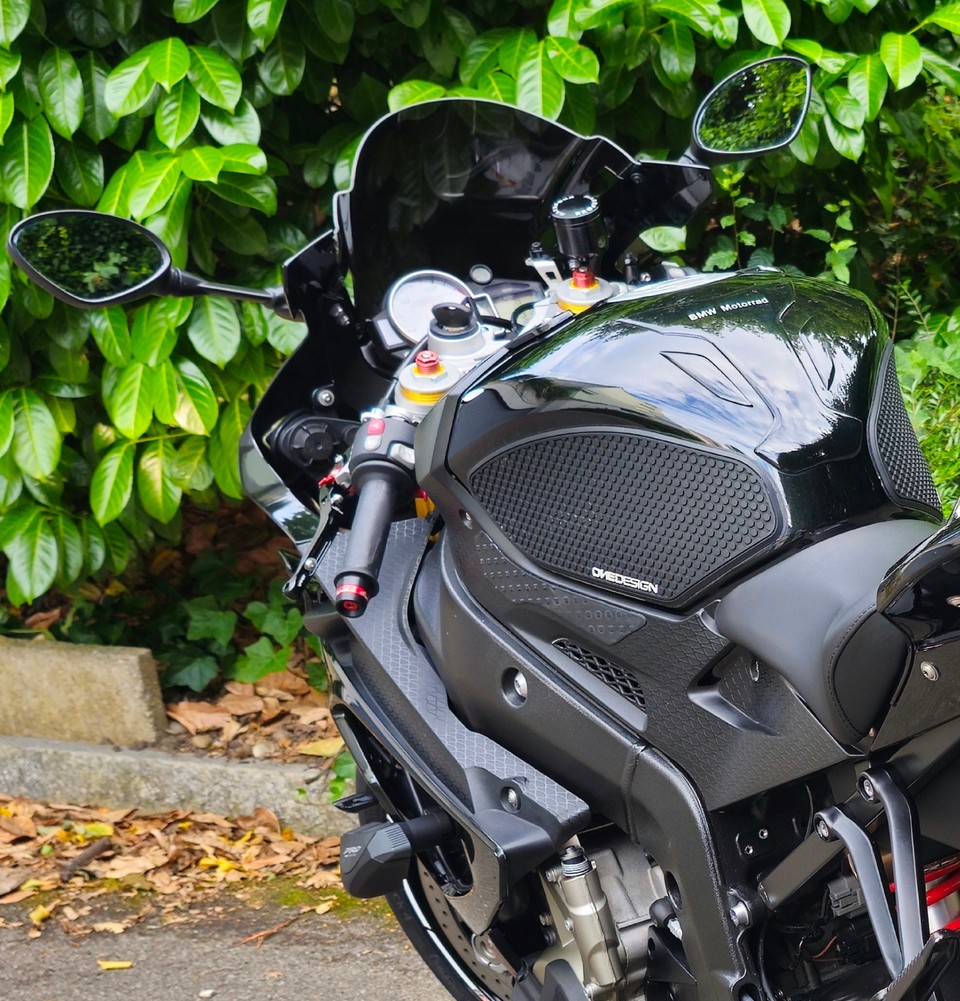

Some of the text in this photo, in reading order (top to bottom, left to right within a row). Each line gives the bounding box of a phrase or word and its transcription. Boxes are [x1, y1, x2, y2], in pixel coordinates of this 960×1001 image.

[688, 297, 769, 321] BMW Motorrad
[591, 566, 659, 594] ONEDESIGN
